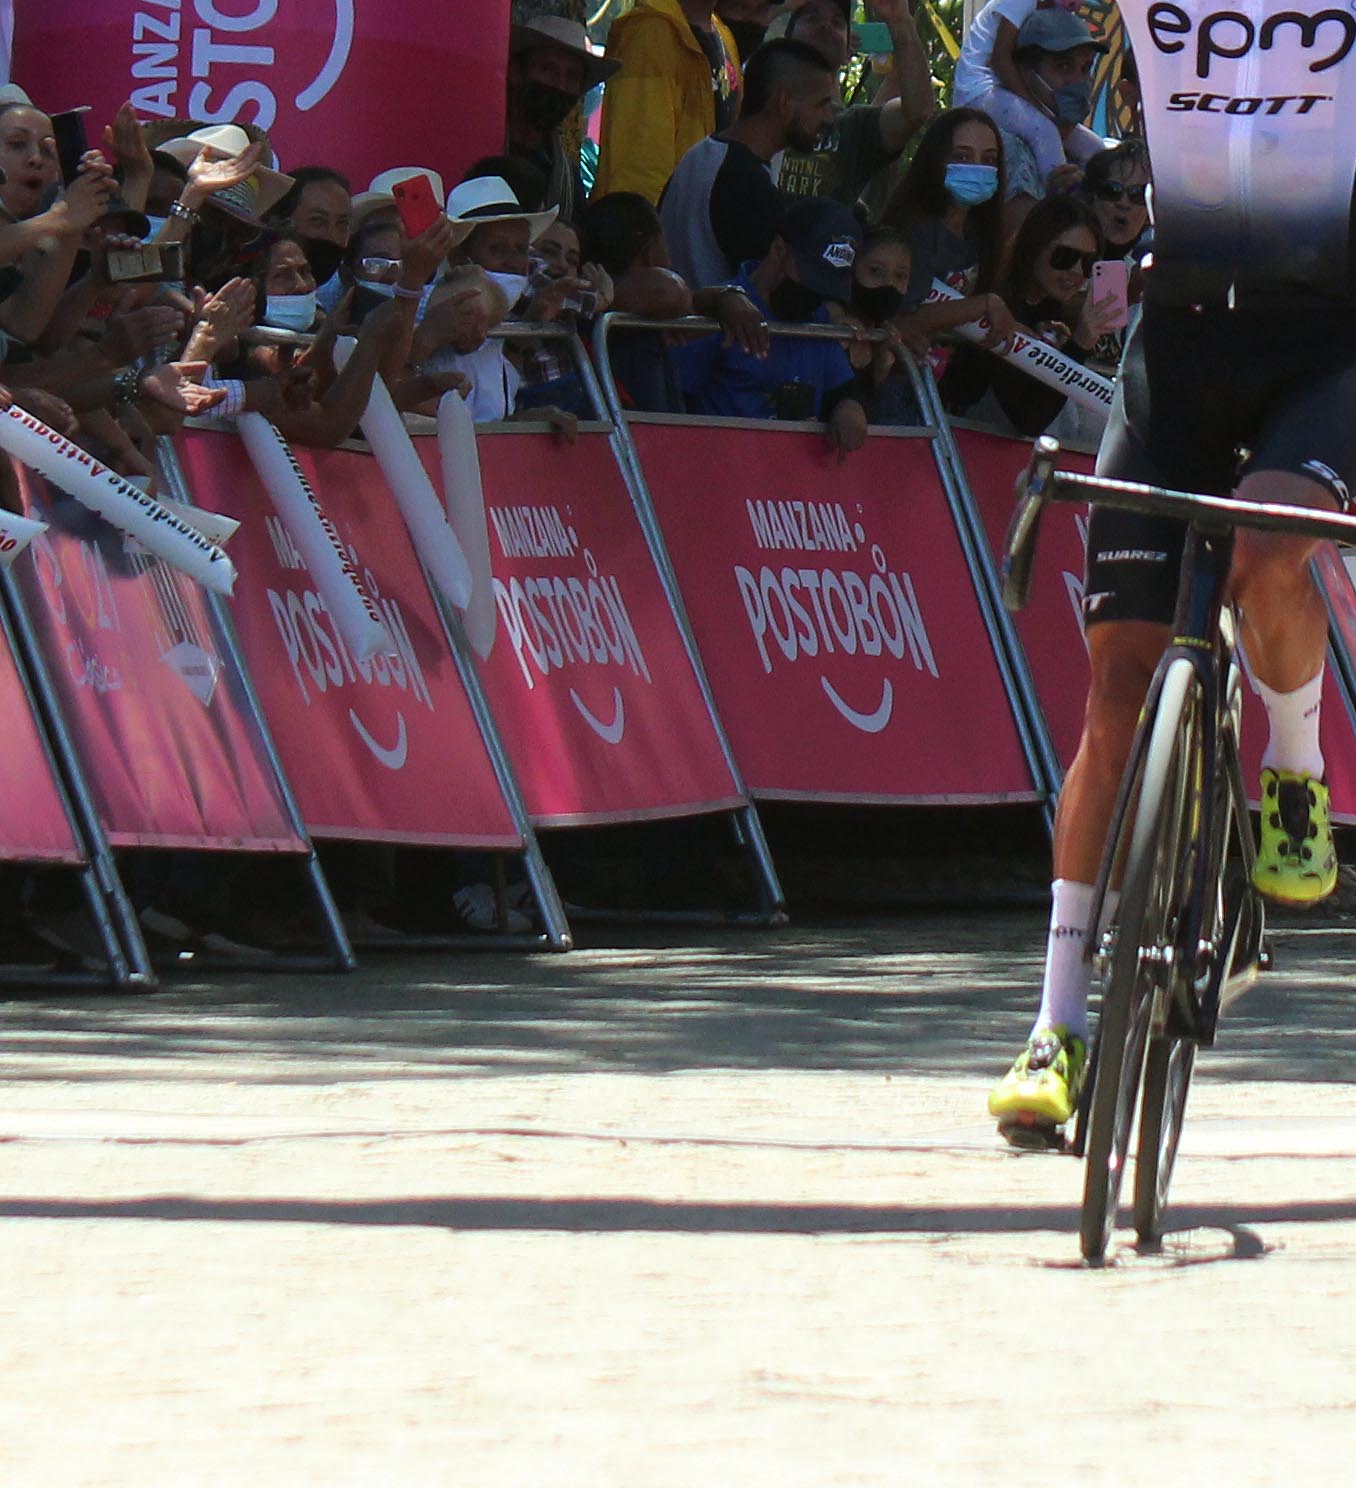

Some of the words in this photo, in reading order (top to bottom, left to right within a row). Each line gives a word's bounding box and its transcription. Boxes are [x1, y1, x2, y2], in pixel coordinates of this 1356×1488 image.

[1165, 91, 1333, 116] SCOTT
[8, 409, 107, 478] Antioque
[746, 497, 858, 553] MANZANA
[1096, 549, 1169, 563] SUAREZ
[266, 587, 436, 712] POSTN
